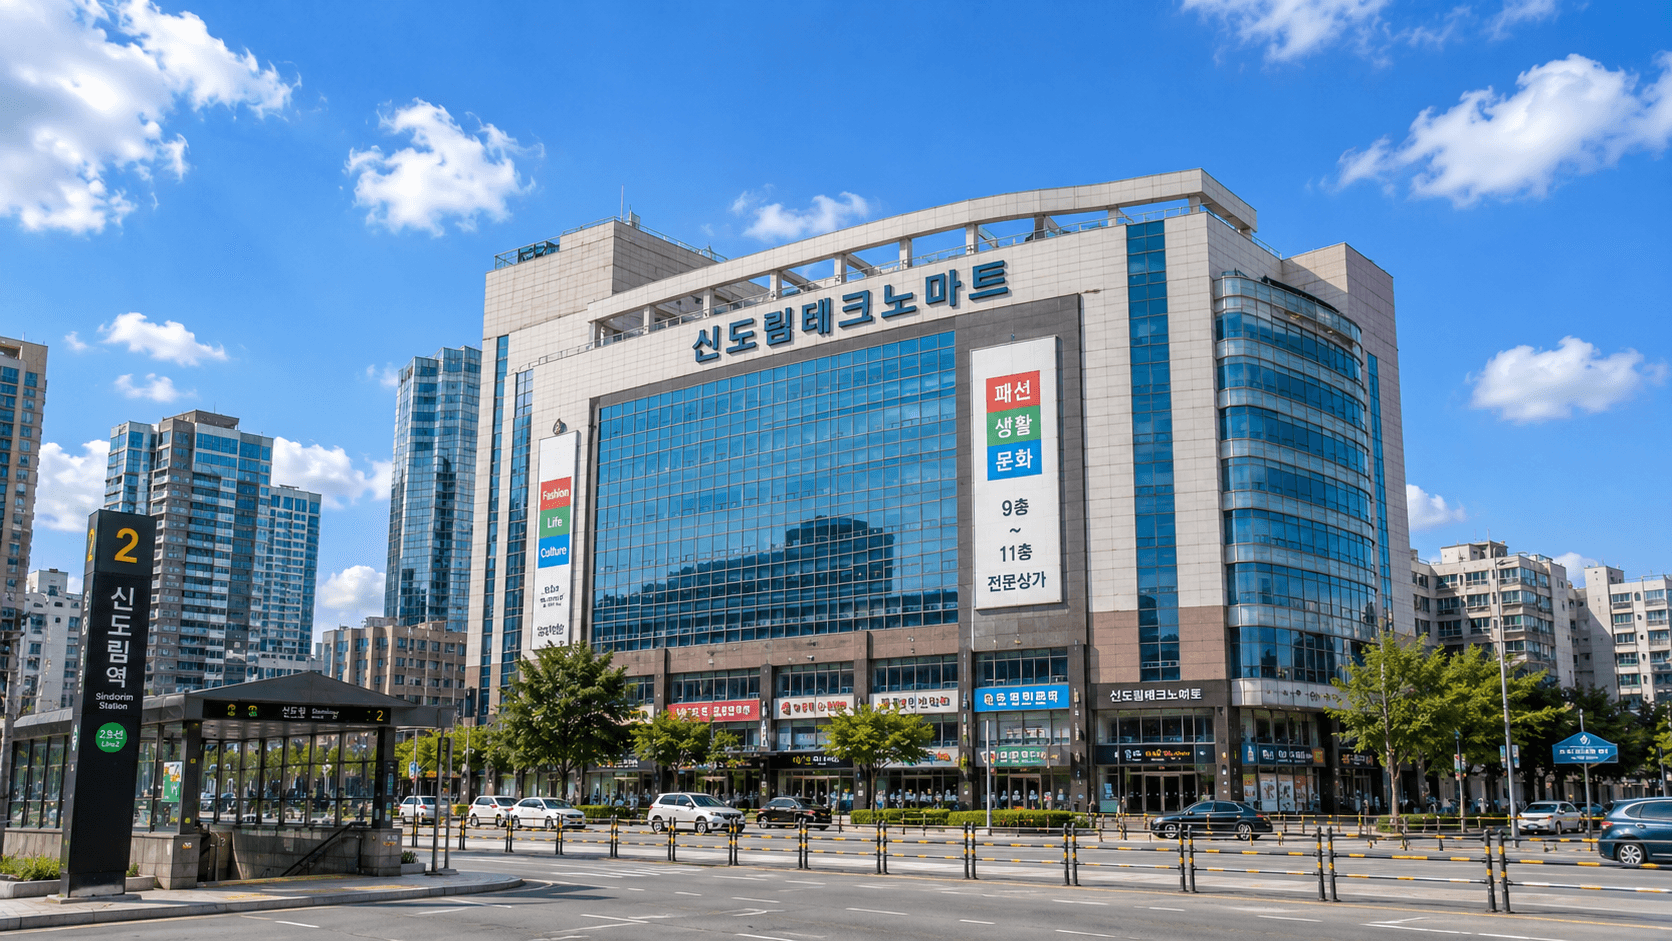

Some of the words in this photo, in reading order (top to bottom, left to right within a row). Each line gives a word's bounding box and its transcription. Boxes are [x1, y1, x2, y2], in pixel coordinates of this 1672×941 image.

[692, 260, 1011, 362] 신도림테크노마트
[994, 379, 1031, 403] 패션
[995, 413, 1032, 438] 생활
[995, 447, 1033, 472] 문화
[542, 488, 569, 500] Fashion
[547, 516, 563, 528] Life
[86, 528, 96, 562] 2
[114, 527, 140, 564] 2
[987, 571, 1047, 593] 전문상가
[106, 586, 135, 688] 신도림역
[99, 701, 128, 710] Station
[376, 710, 384, 721] 2
